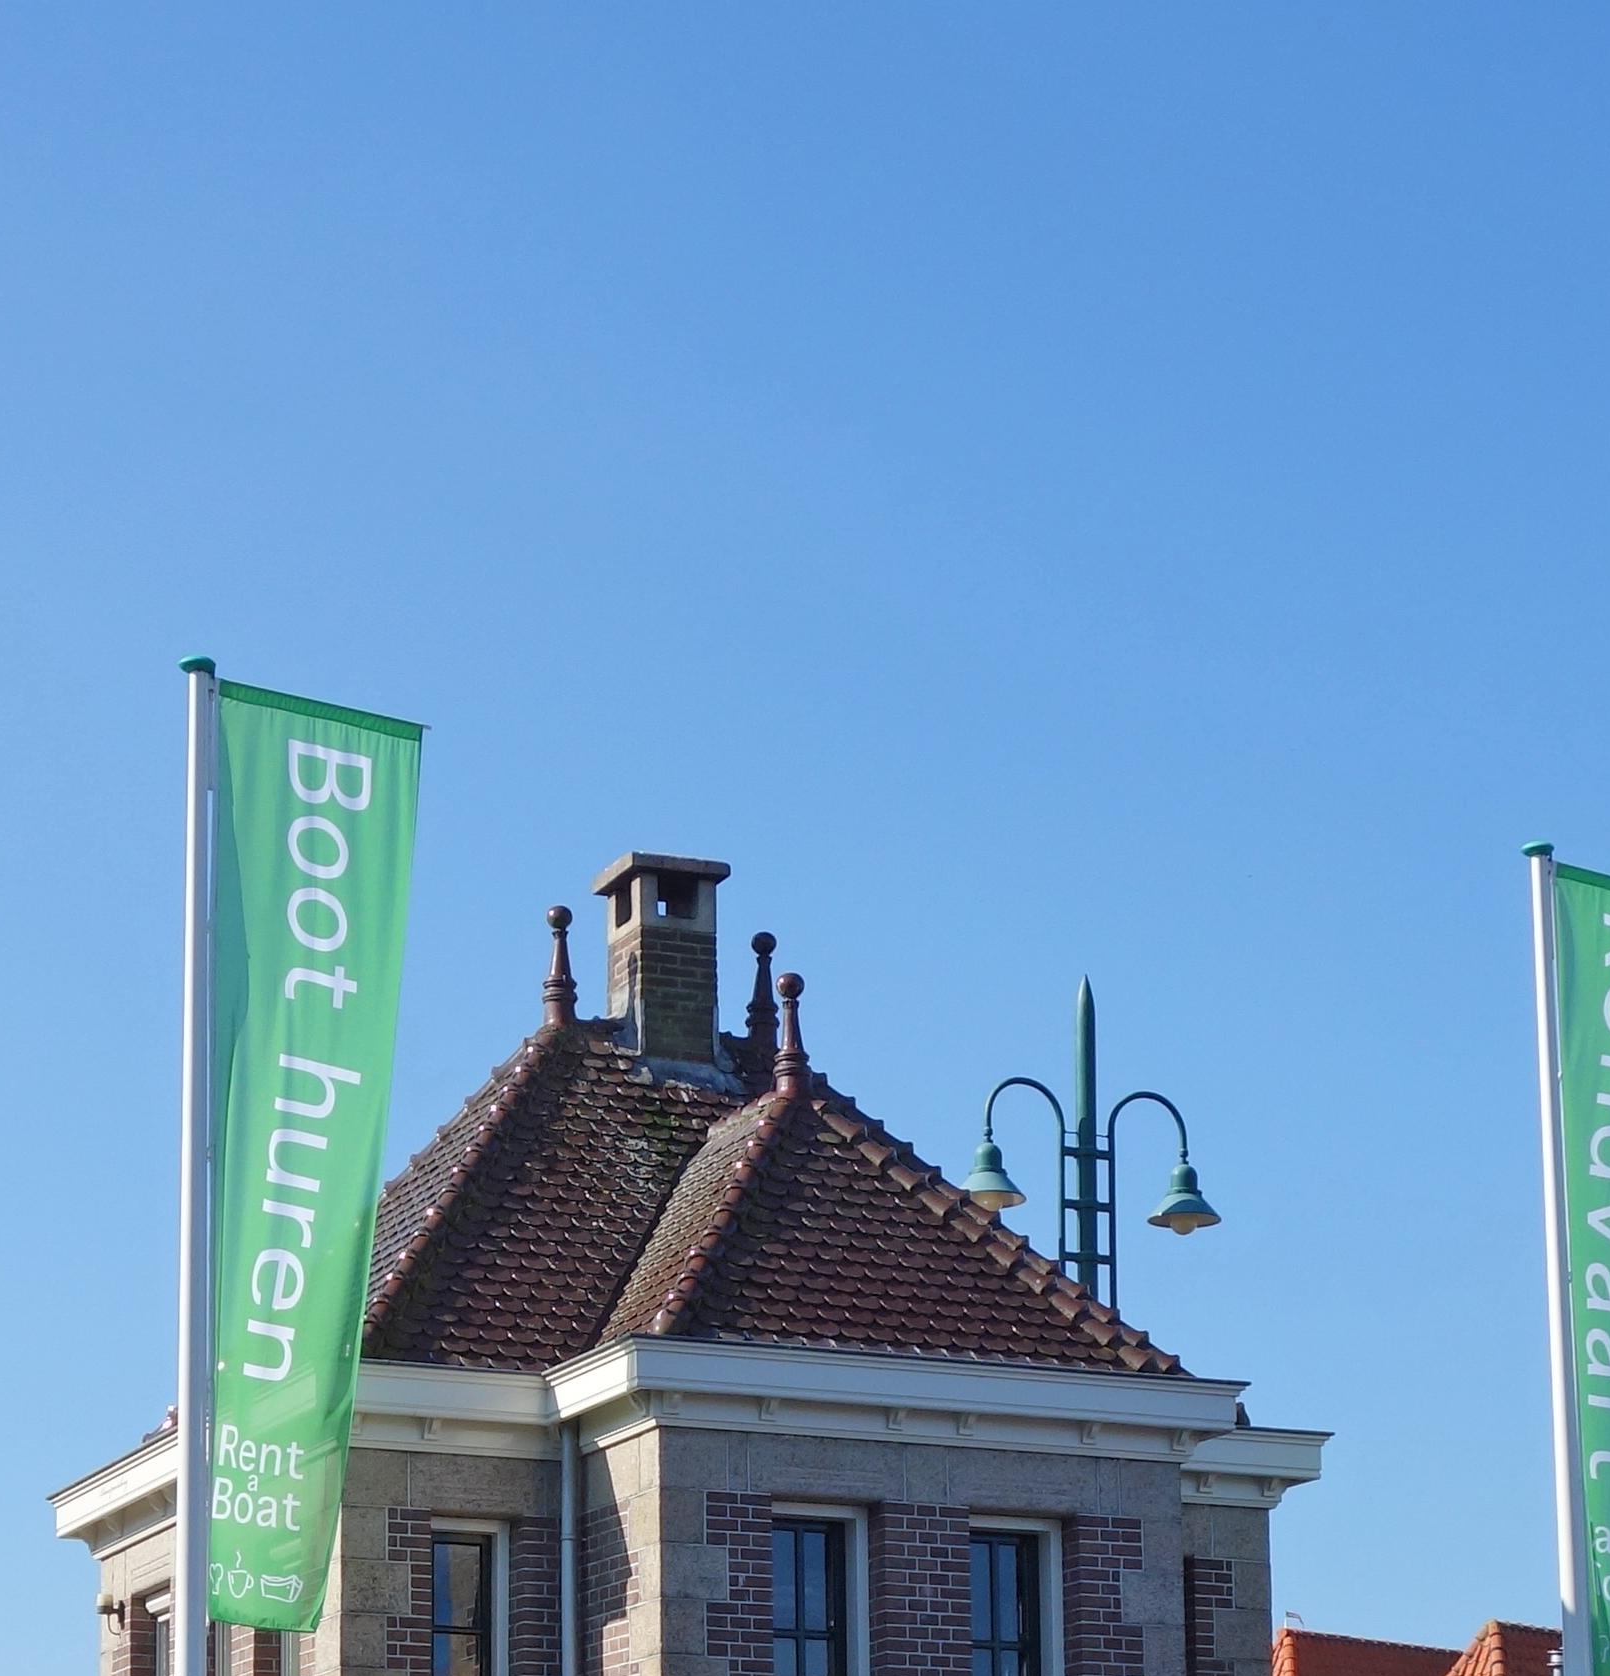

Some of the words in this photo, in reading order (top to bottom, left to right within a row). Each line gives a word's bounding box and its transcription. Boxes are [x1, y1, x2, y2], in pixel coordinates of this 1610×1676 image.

[284, 737, 372, 1010] Boot
[243, 1053, 362, 1383] huren
[218, 1424, 304, 1480] Rent
[212, 1477, 301, 1532] Boat
[246, 1473, 259, 1492] a
